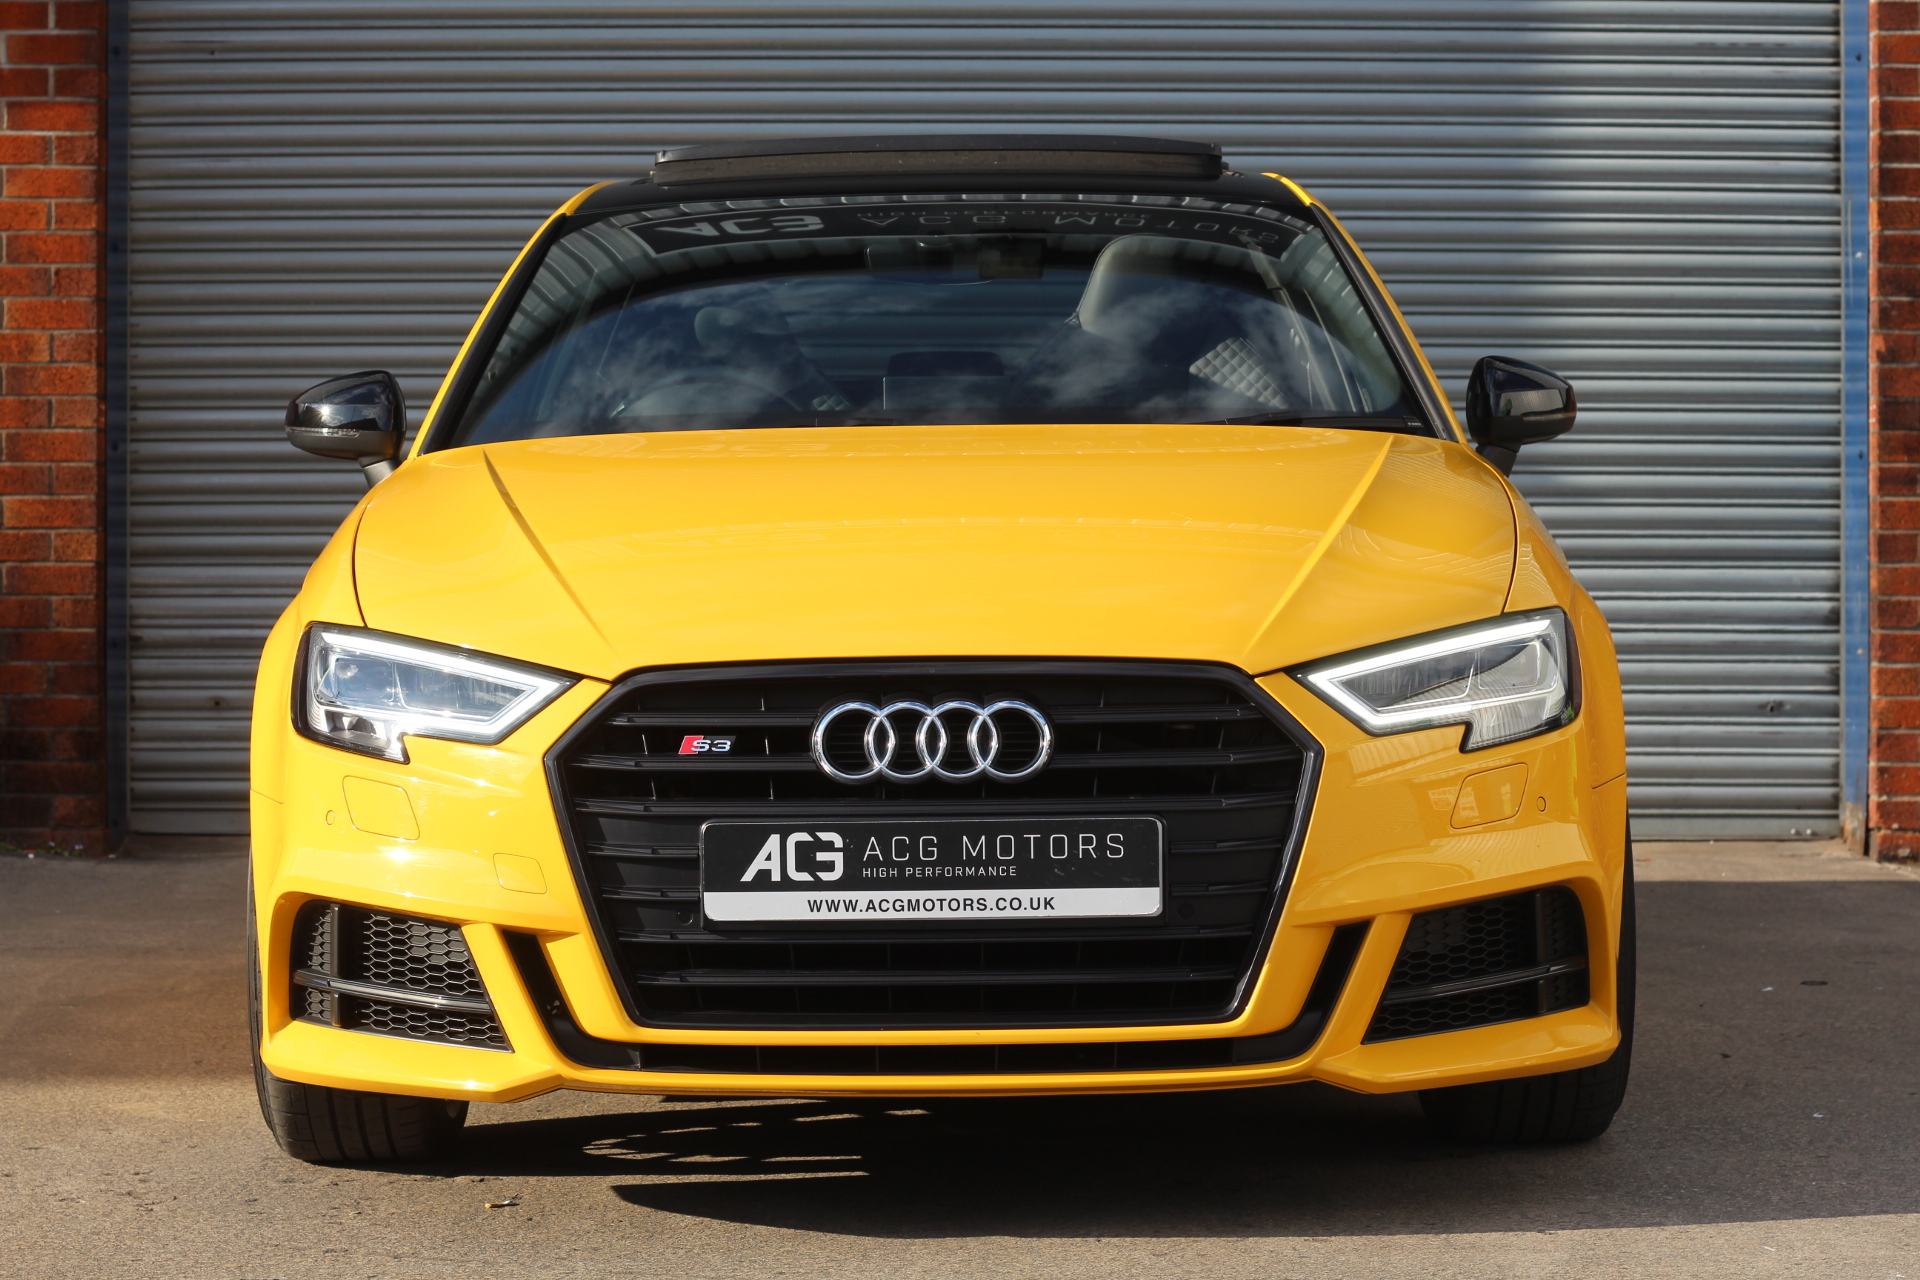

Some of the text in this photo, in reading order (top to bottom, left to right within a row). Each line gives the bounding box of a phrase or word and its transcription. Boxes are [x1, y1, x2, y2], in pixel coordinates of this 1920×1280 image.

[690, 739, 731, 752] S3
[862, 833, 1124, 862] ACG MOTORS
[739, 831, 844, 882] ACG
[862, 866, 1017, 878] HIGH PERFORMANCE
[807, 896, 1056, 913] WWW.ACGMOTORS.CO.UK
